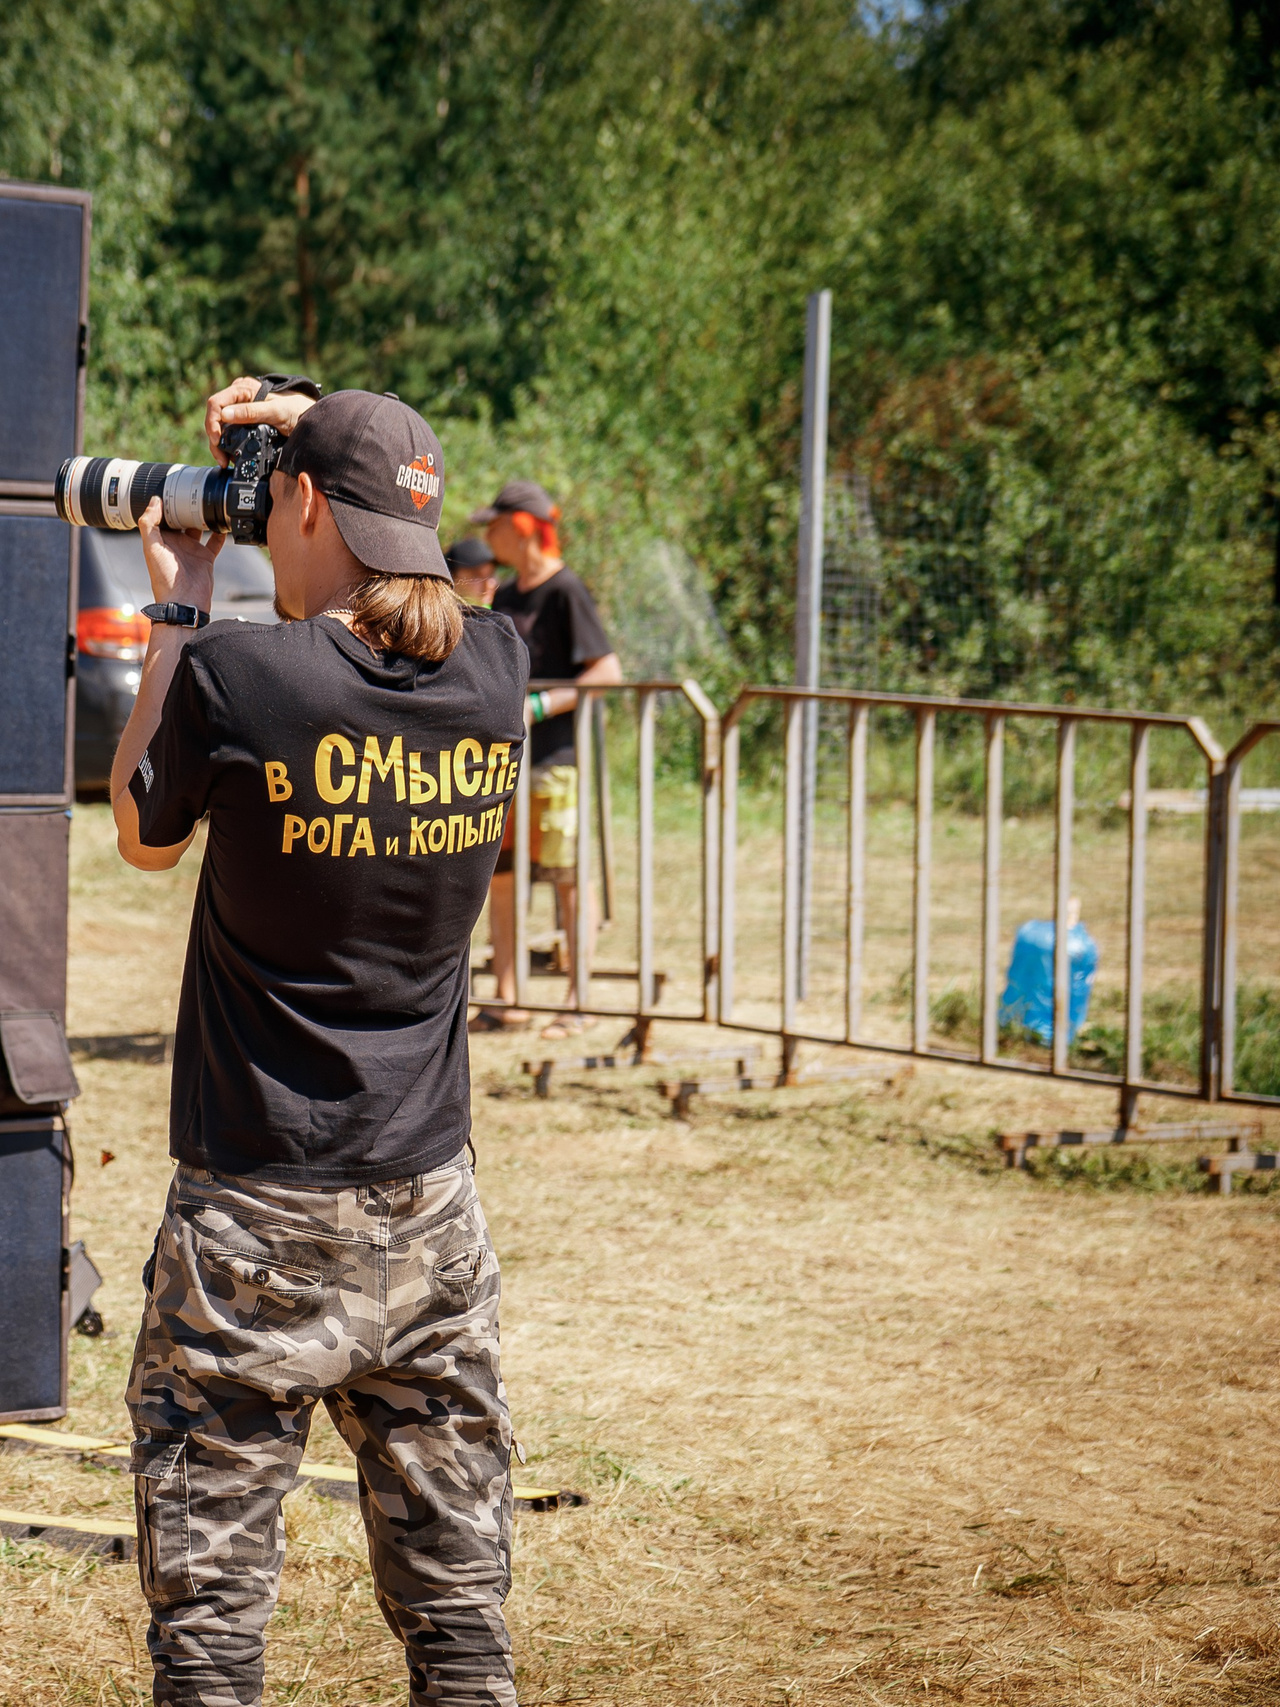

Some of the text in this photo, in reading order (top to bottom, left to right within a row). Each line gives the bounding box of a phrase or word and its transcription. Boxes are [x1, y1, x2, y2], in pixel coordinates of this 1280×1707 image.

[264, 733, 518, 805] В СМЫСЛЕ
[281, 813, 377, 858] РОГА
[408, 801, 504, 856] КОПЫТА
